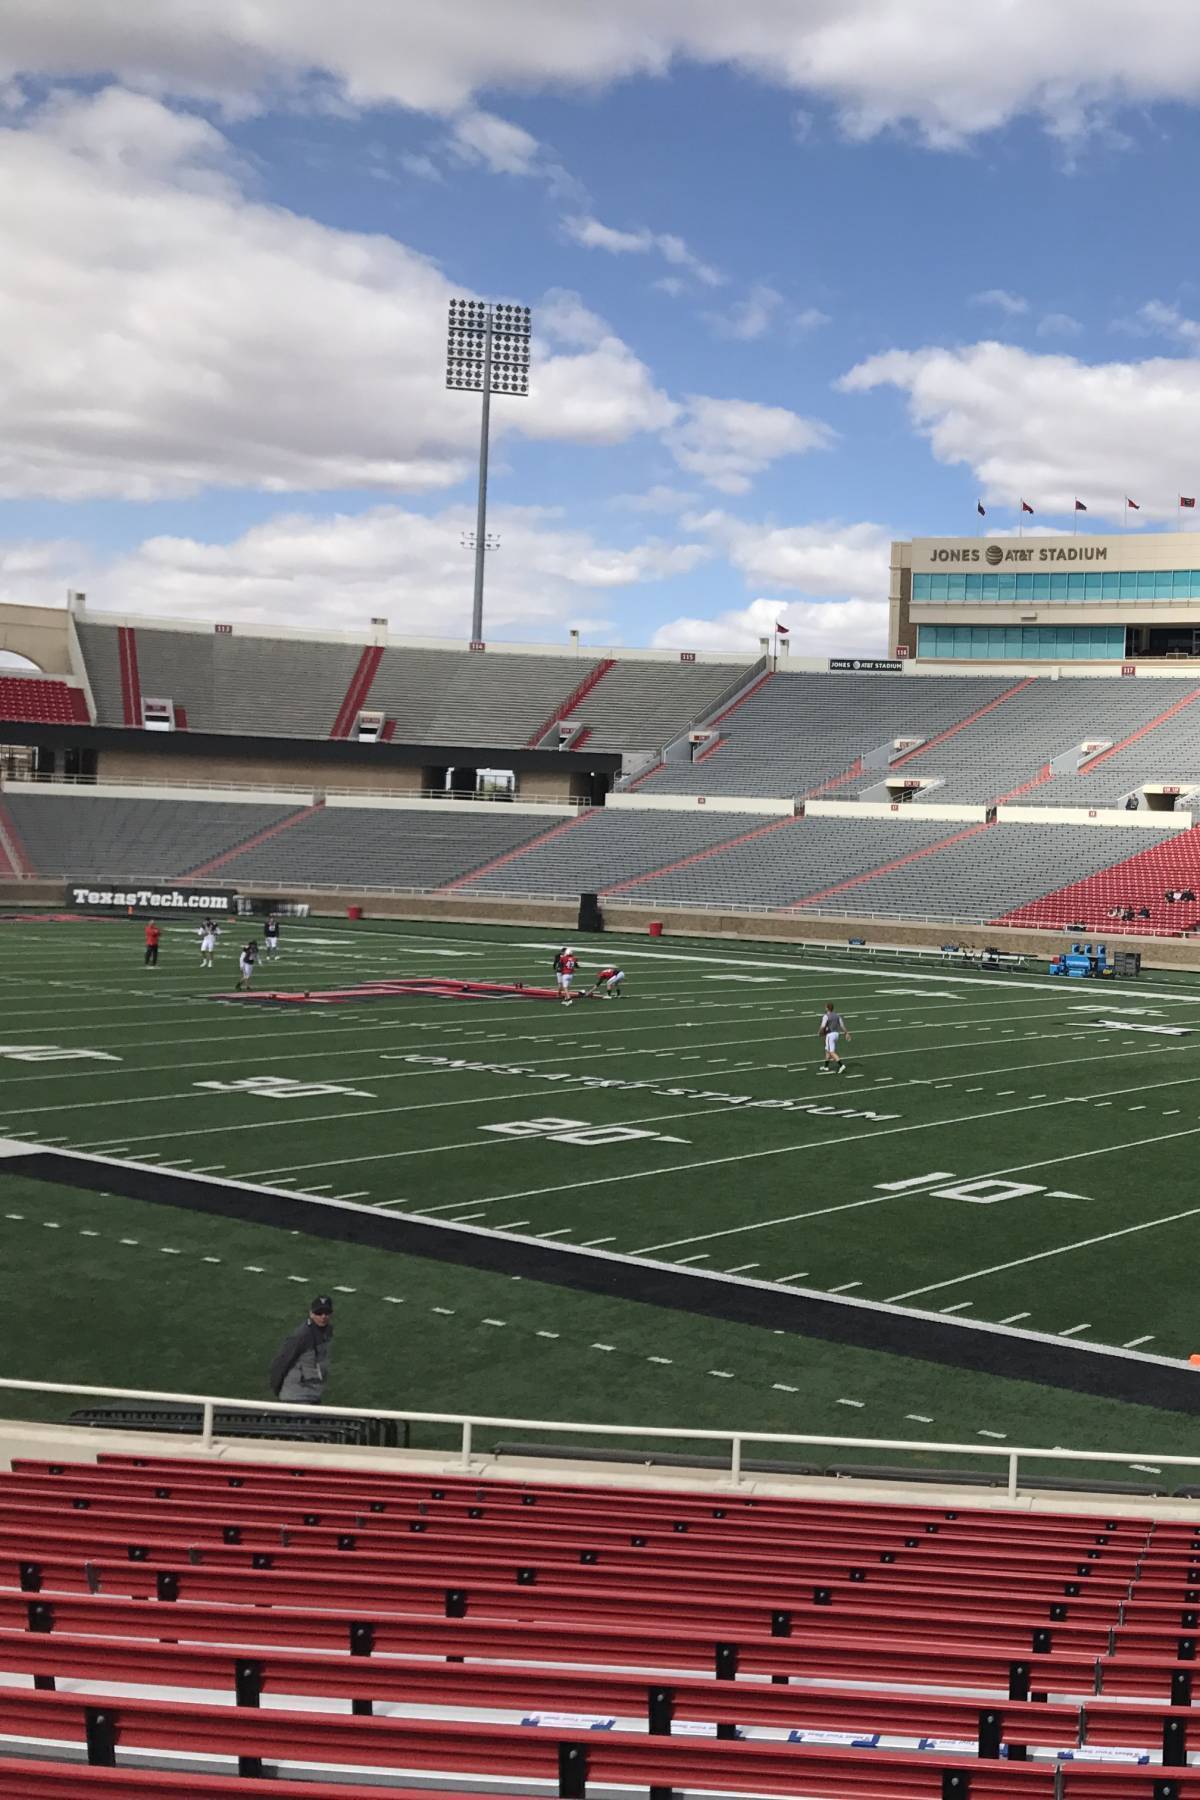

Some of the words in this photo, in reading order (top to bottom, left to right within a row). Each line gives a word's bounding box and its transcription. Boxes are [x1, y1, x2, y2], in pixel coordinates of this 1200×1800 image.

[930, 549, 980, 562] JONES
[1004, 549, 1034, 562] AT&T
[1039, 547, 1108, 561] STADIUM
[73, 889, 228, 909] TexasTech.com
[192, 1075, 356, 1098] 30
[379, 1054, 536, 1075] JONES
[651, 1088, 903, 1122] STADIUM
[476, 1117, 661, 1146] 20
[872, 1171, 1048, 1204] 10
